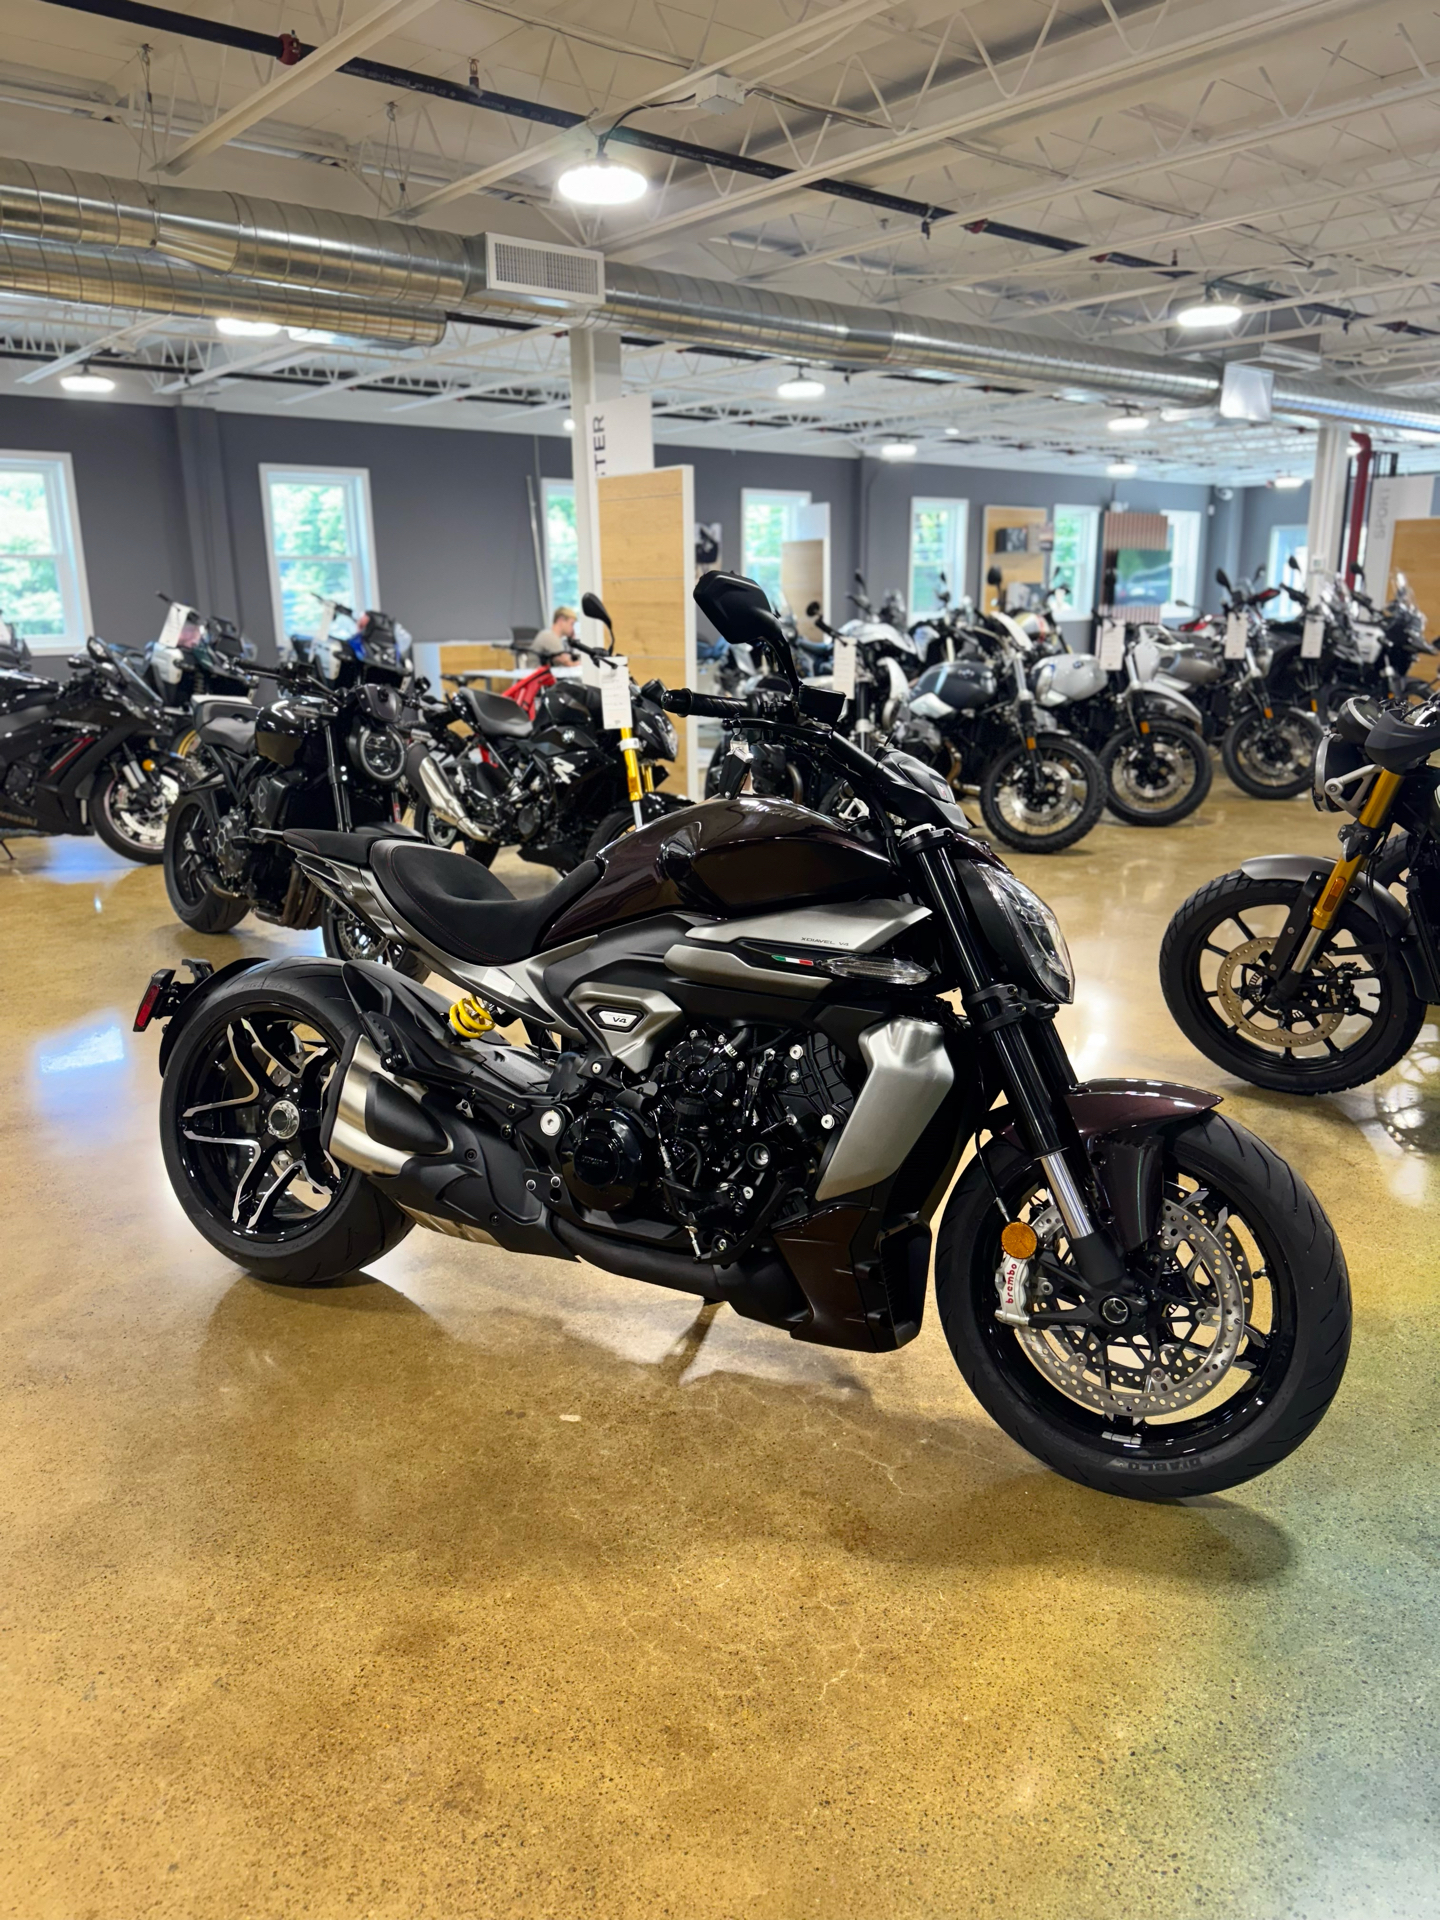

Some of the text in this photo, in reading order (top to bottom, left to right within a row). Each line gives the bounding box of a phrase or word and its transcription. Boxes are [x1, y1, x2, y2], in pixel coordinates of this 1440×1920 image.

[593, 415, 606, 476] TER
[742, 804, 809, 820] DUCATI
[612, 1016, 627, 1024] V4
[1005, 1263, 1018, 1304] brembo
[1128, 1456, 1203, 1471] DIABLO
